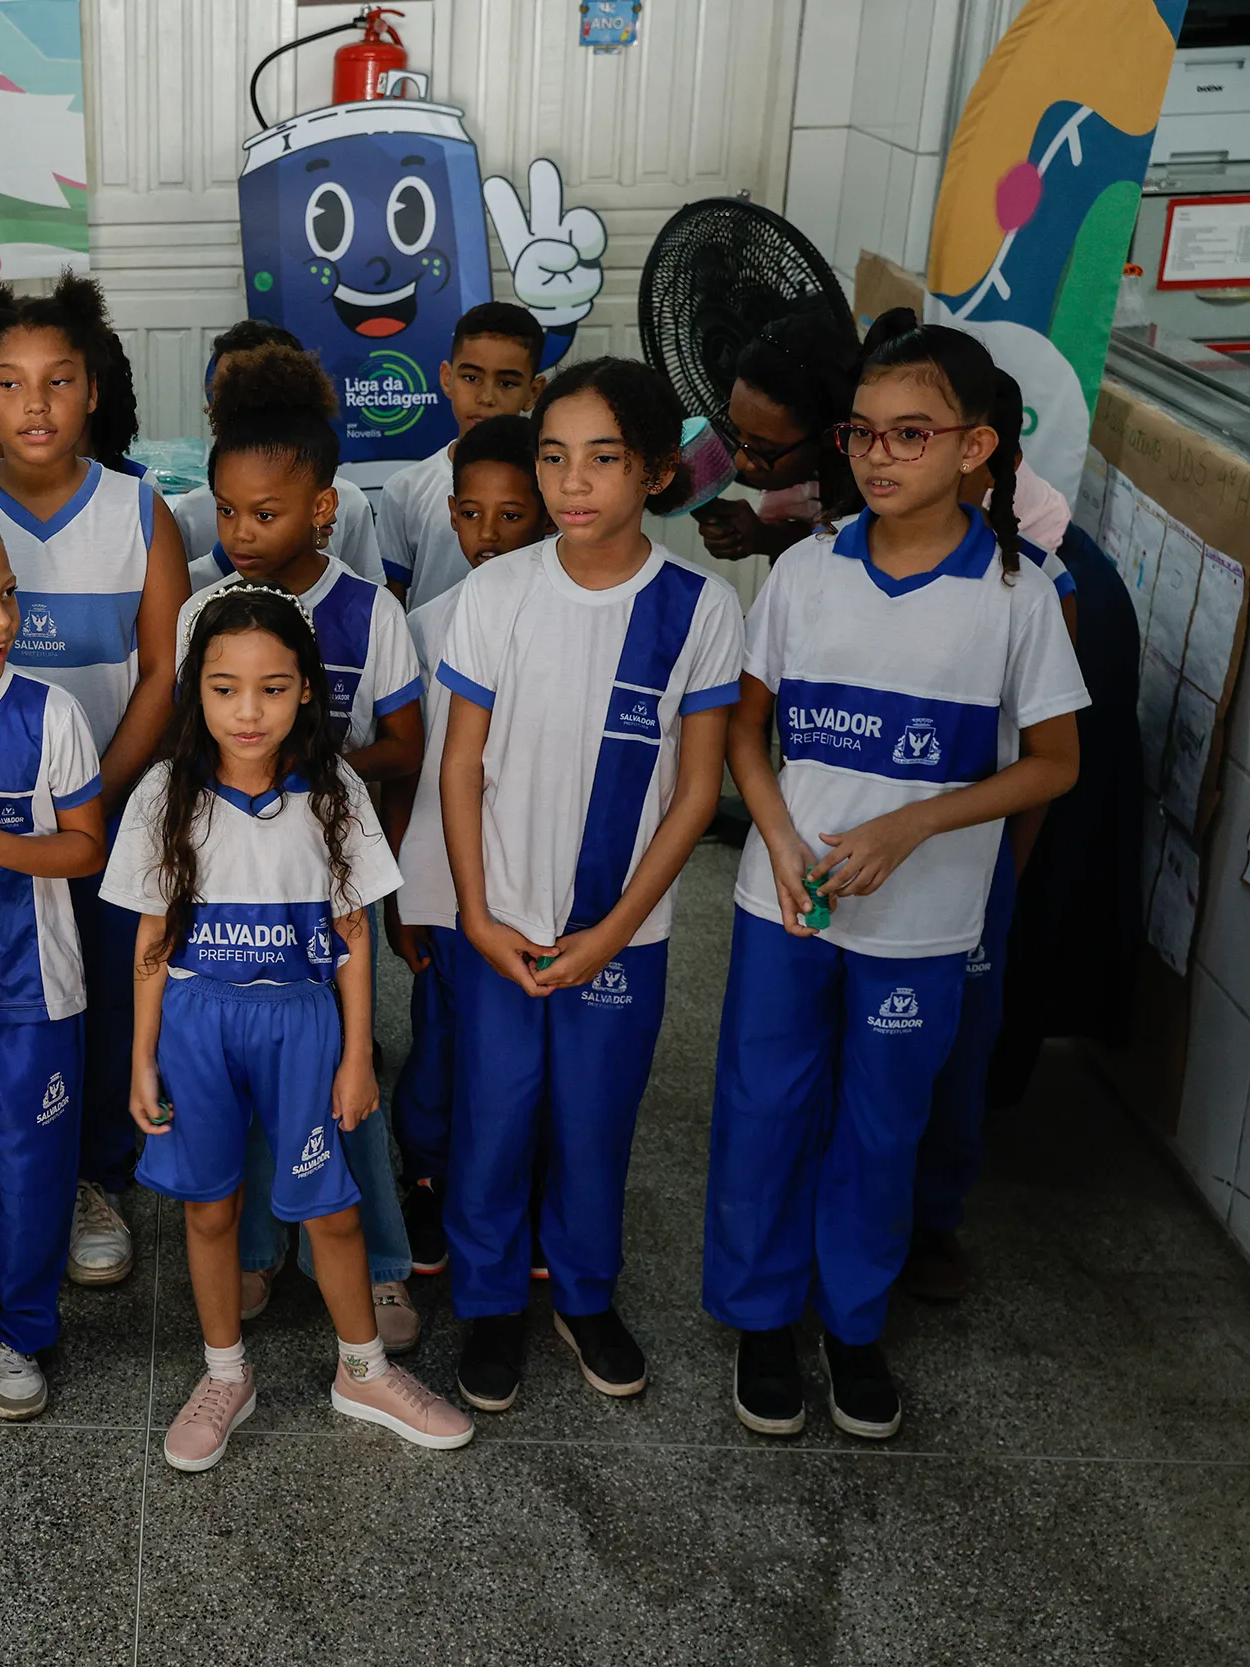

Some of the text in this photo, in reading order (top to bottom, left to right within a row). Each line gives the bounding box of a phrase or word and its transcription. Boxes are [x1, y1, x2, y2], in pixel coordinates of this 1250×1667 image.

[591, 16, 623, 30] ANO
[344, 376, 404, 396] Liga da
[344, 391, 439, 409] Reciclagem
[346, 429, 382, 438] Novelis
[14, 640, 66, 651] SALVADOR
[619, 713, 656, 727] SALVADOR
[188, 922, 298, 947] SALVADOR
[198, 949, 286, 964] PREFEITURA
[581, 990, 633, 1004] SALVADOR
[867, 1015, 923, 1029] SALVADOR
[36, 1095, 70, 1124] SALVADOR
[291, 1149, 331, 1175] SALVADOR
